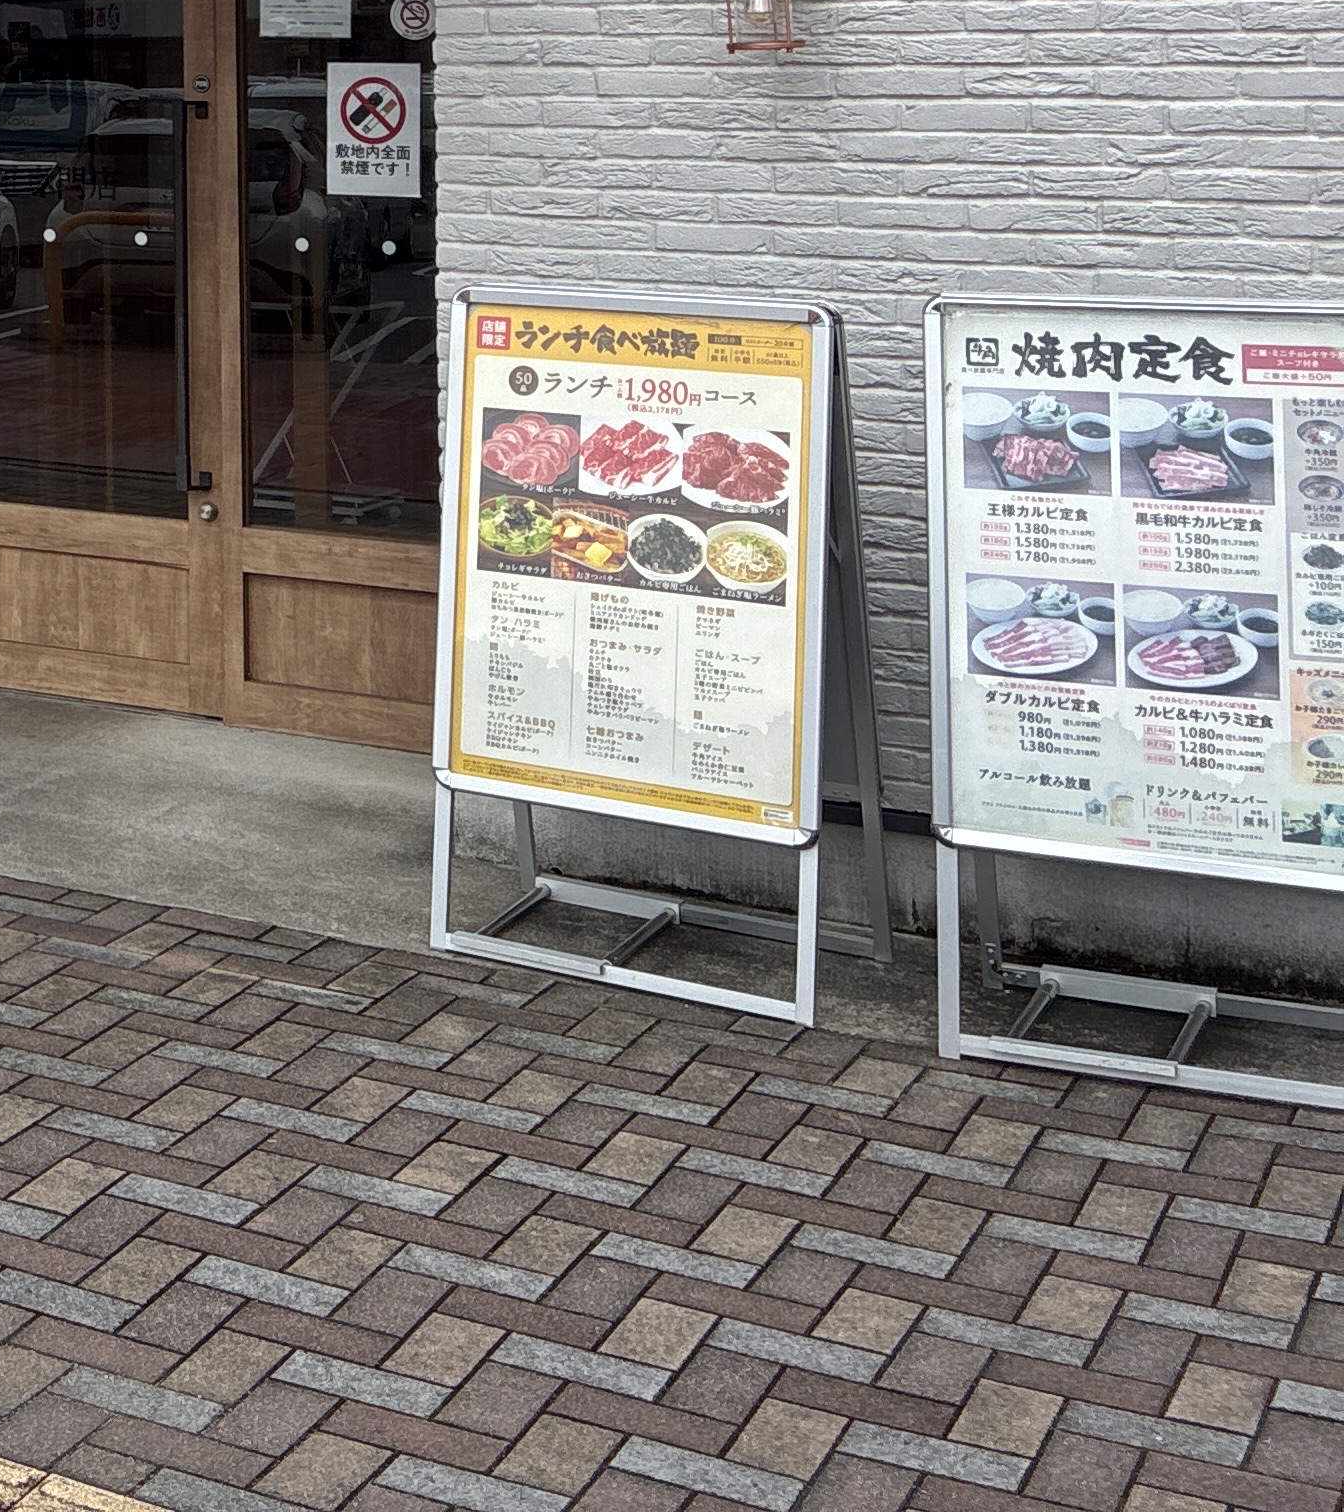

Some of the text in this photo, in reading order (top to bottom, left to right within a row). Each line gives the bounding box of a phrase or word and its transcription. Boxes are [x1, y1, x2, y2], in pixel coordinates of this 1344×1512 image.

[334, 143, 411, 162] 敷地内全面
[481, 333, 506, 347] 限定
[514, 320, 701, 360] ランチ食べ放題
[1011, 331, 1236, 386] 焼肉定食
[515, 371, 532, 385] 50
[544, 372, 613, 399] ランチ
[624, 378, 702, 407] 1,980円
[704, 389, 758, 406] コース
[987, 503, 1089, 522] 王様カルビ定食
[1014, 522, 1056, 536] 1,380円
[1135, 512, 1263, 532] 黒毛和牛カルビ定食
[1014, 536, 1057, 550] 1,580円
[1174, 532, 1219, 546] 1,580円
[1015, 550, 1057, 564] 1,780円
[1174, 547, 1219, 560] 1,980円
[1174, 561, 1219, 575] 2,380円
[985, 690, 1101, 714] ダブルカルビ定食
[1017, 710, 1051, 725] 980円
[1135, 704, 1274, 730] カルビ&牛ハラミ定食
[1019, 725, 1061, 739] 1,180円
[1179, 726, 1223, 741] 1,080円
[1019, 739, 1061, 754] 1,380円
[1179, 740, 1224, 756] 1,280円
[1179, 755, 1224, 771] 1,480円
[979, 768, 1092, 792] アルコール飲み放題
